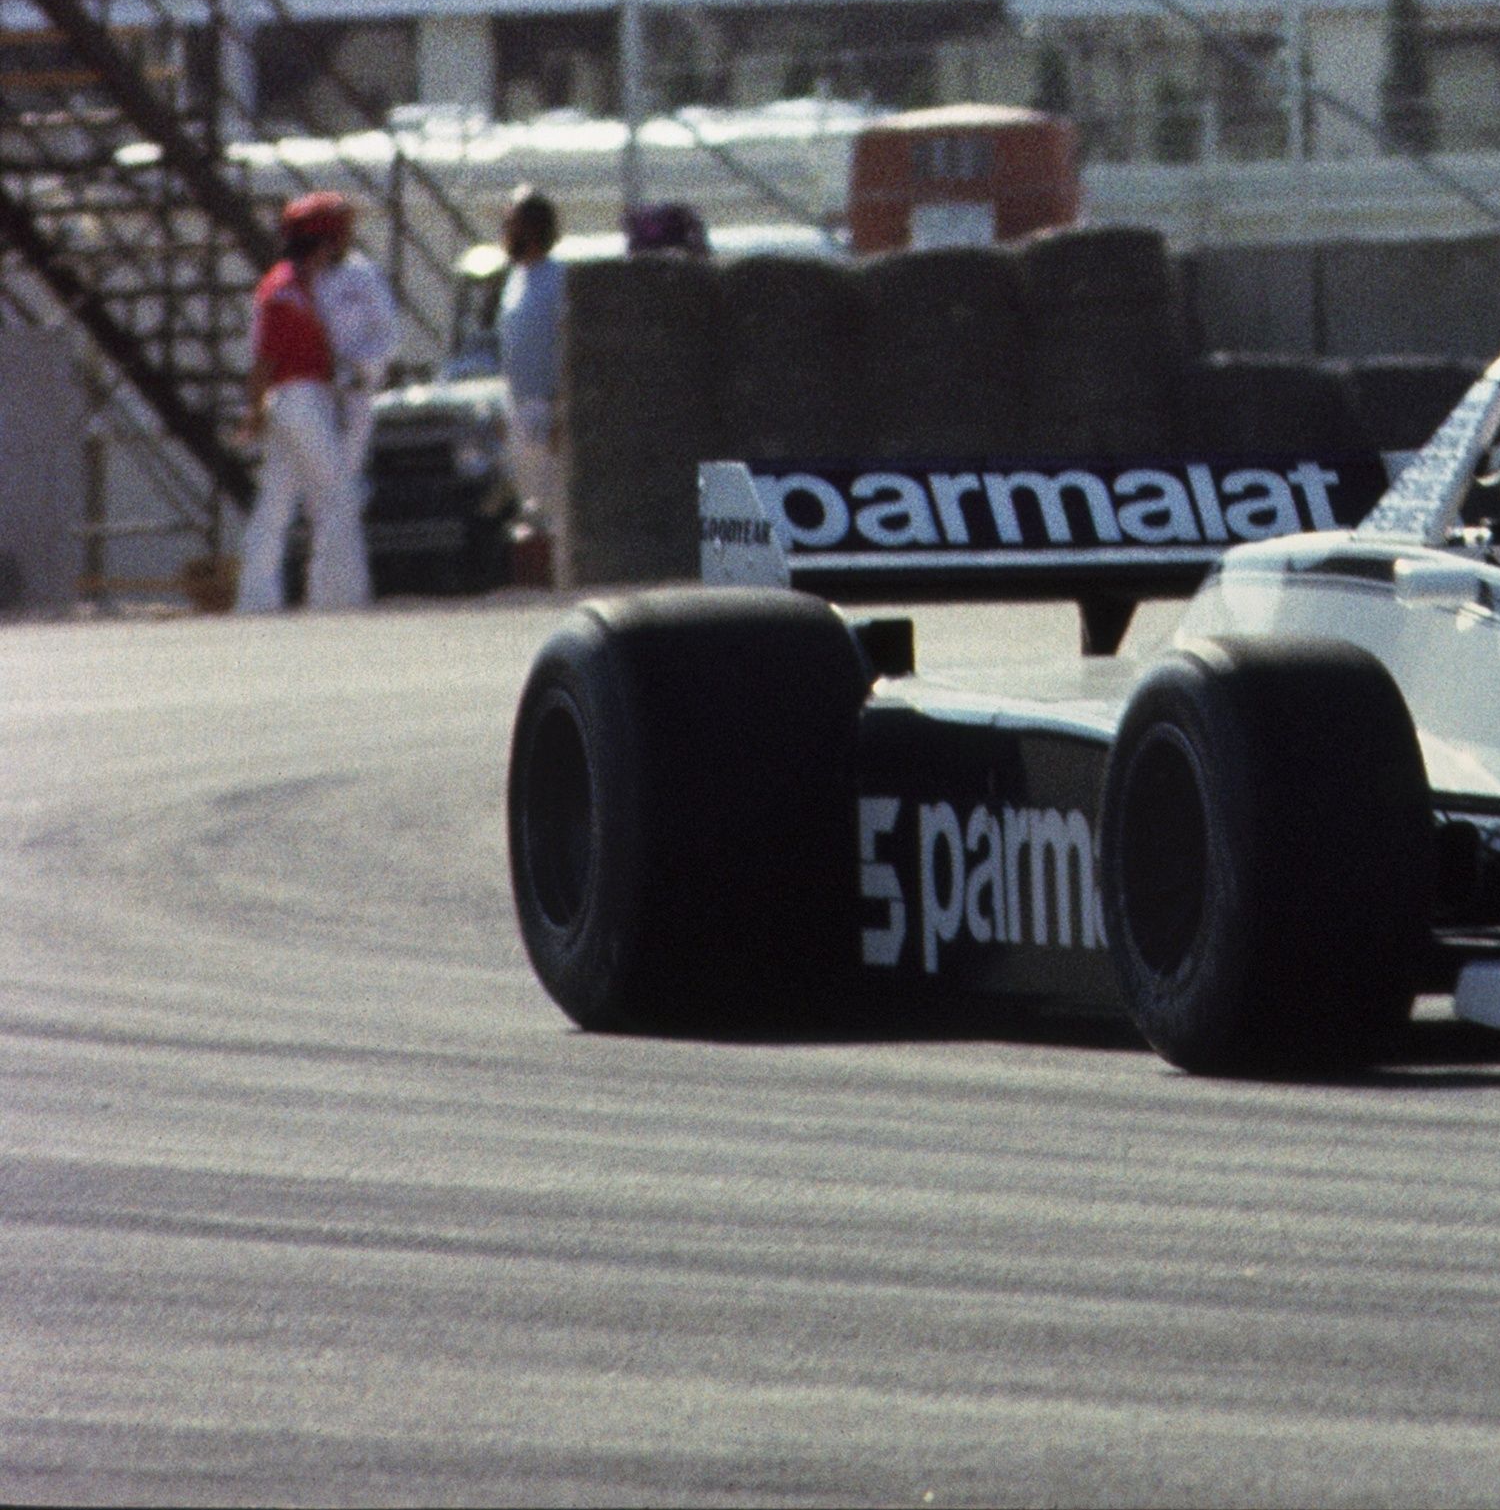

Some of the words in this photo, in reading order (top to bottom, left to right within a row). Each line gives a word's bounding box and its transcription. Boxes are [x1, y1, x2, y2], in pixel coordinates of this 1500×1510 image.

[753, 461, 1338, 549] parmalat
[858, 796, 907, 967] 5
[918, 801, 1108, 973] parm
